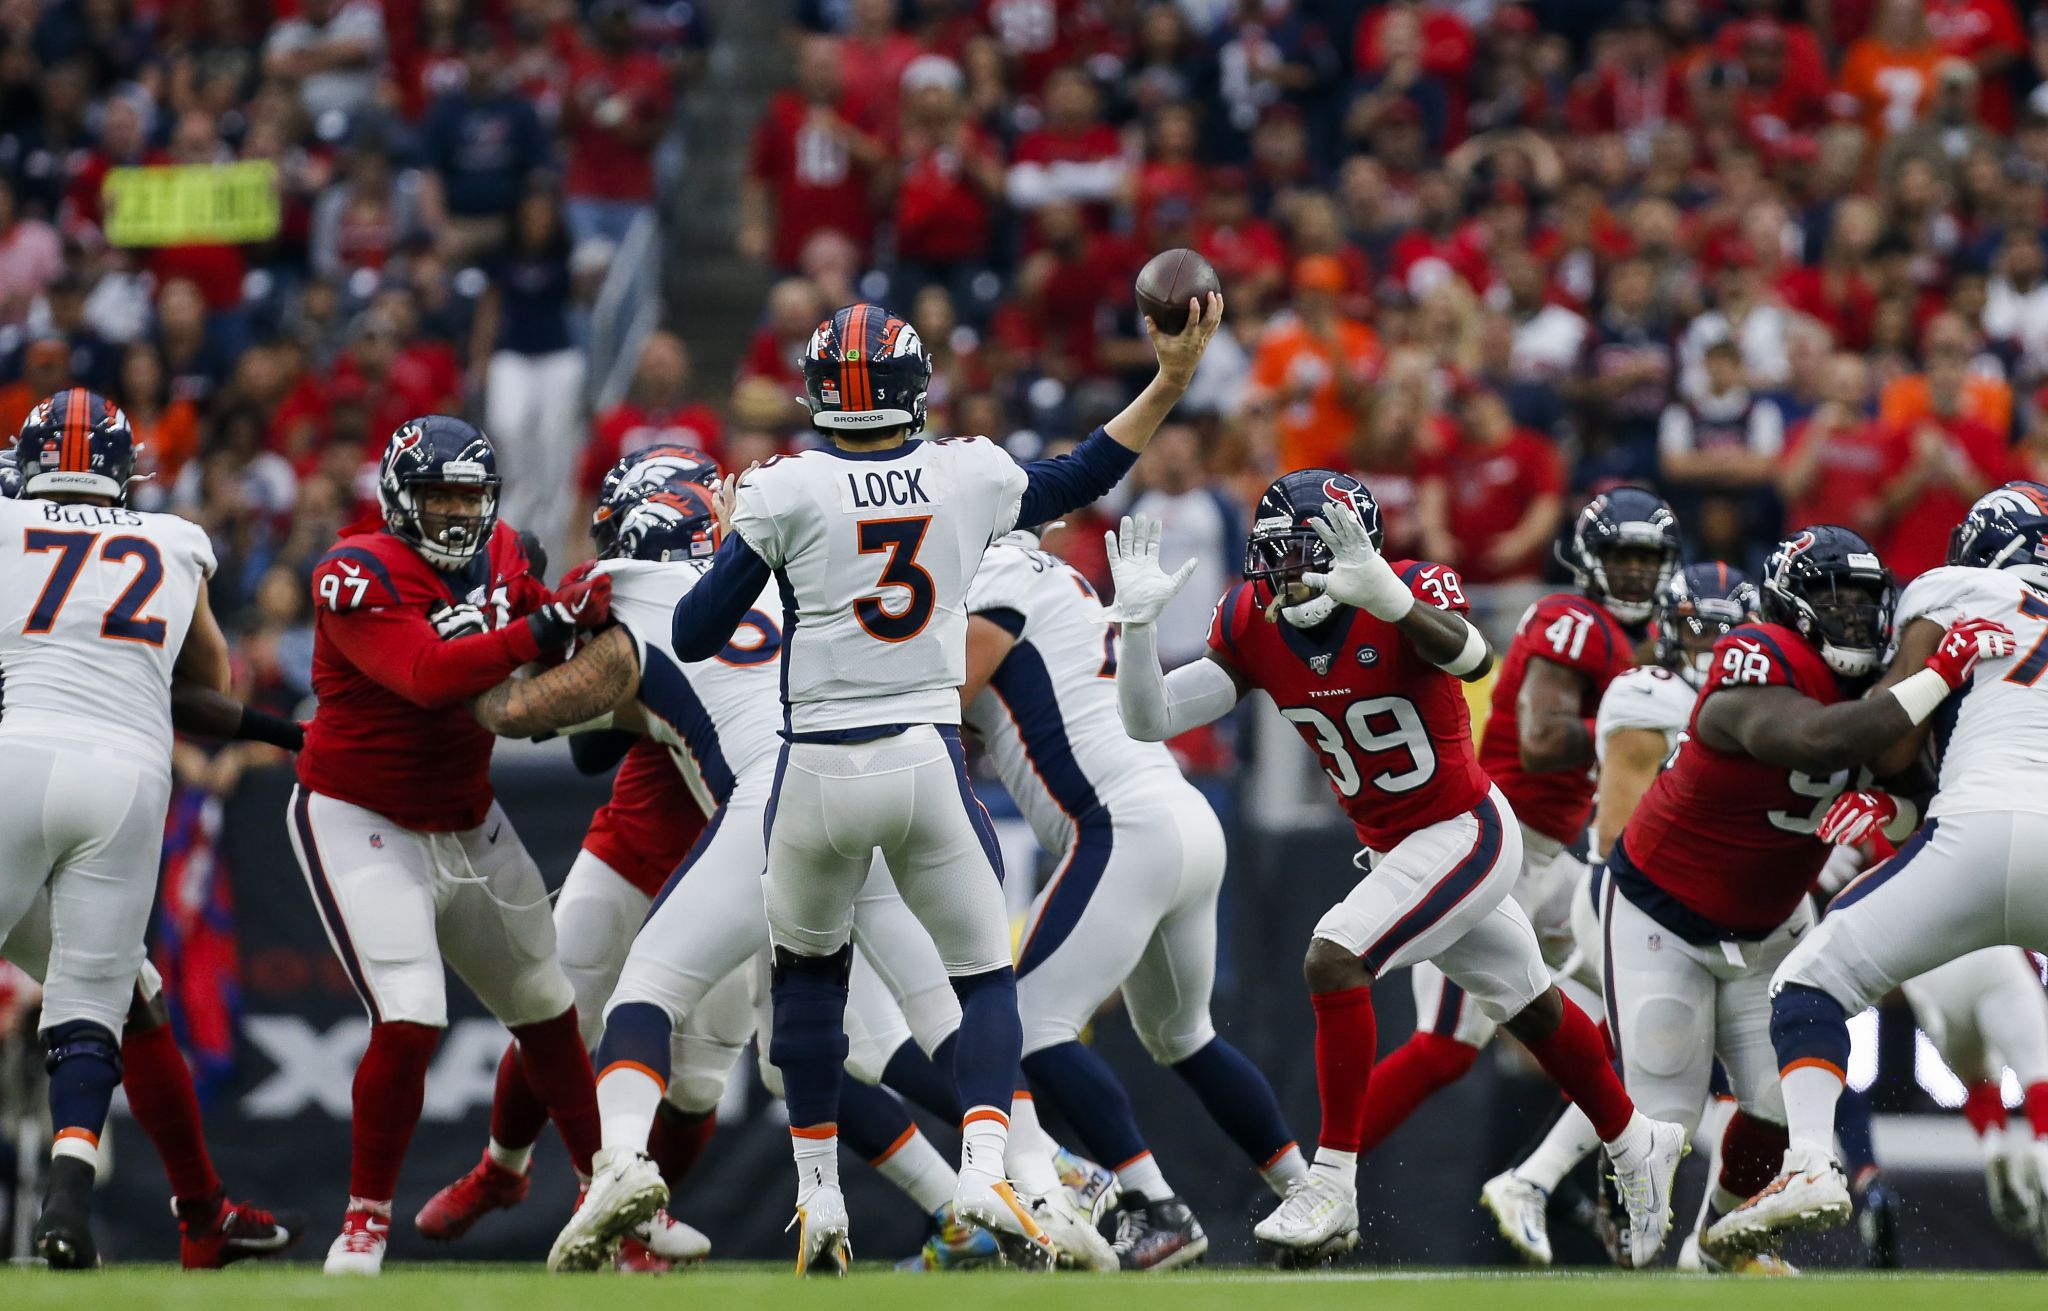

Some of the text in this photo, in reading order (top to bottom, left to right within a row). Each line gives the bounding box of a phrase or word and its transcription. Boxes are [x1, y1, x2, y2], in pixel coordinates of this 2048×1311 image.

[877, 388, 885, 400] 3
[833, 415, 884, 423] BRONCOS
[91, 453, 105, 467] 72
[847, 467, 930, 508] LOCK
[22, 528, 168, 648] 72
[320, 573, 370, 612] 97
[852, 514, 936, 643] 3
[1421, 571, 1466, 611] 39
[1545, 614, 1593, 660] 41
[2002, 588, 2048, 687] 7
[1721, 647, 1771, 685] 98
[1309, 688, 1352, 698] TEXANS
[1279, 696, 1438, 798] 39
